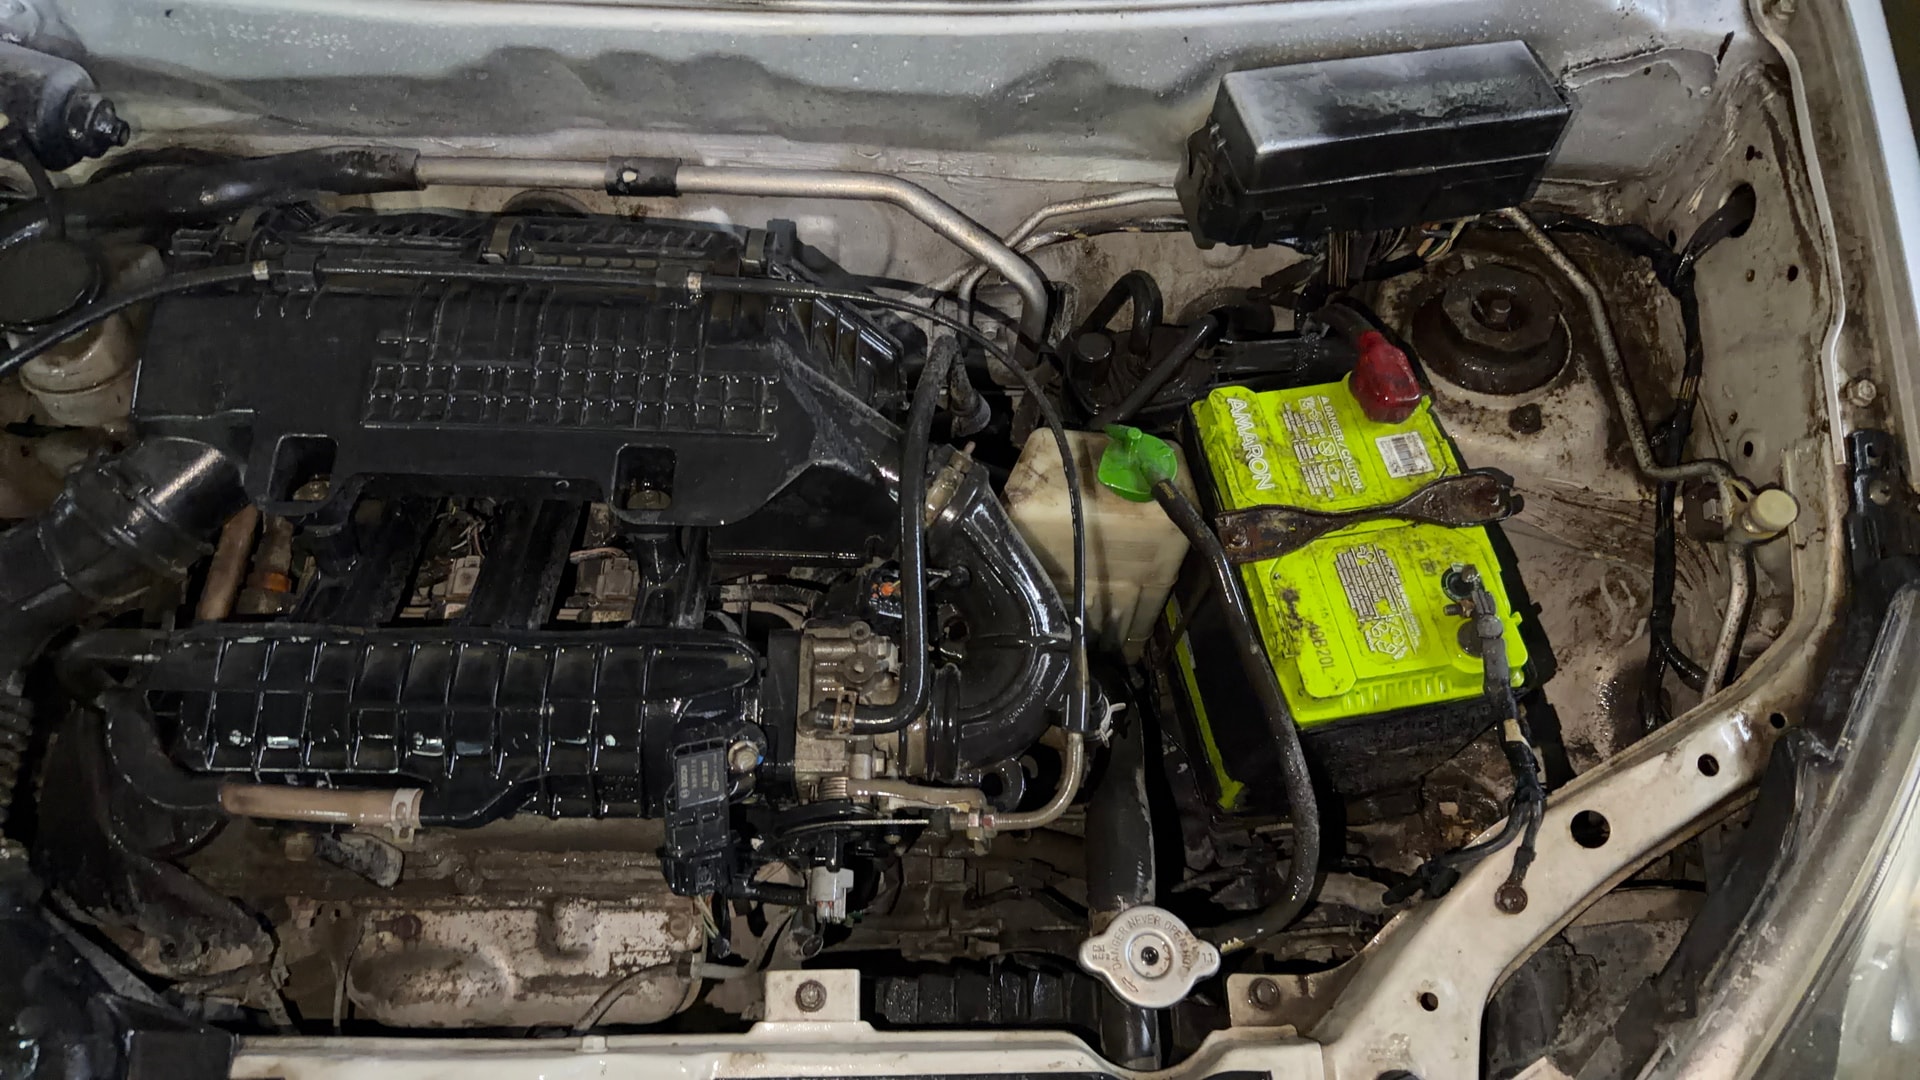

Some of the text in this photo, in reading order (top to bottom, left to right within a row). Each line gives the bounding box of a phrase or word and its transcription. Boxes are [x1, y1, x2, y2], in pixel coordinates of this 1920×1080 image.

[1226, 397, 1275, 491] AMARON
[1324, 404, 1344, 441] DANGER
[1341, 448, 1362, 489] CAUTION
[1111, 926, 1129, 971] DANGER
[1127, 914, 1161, 928] NEVER
